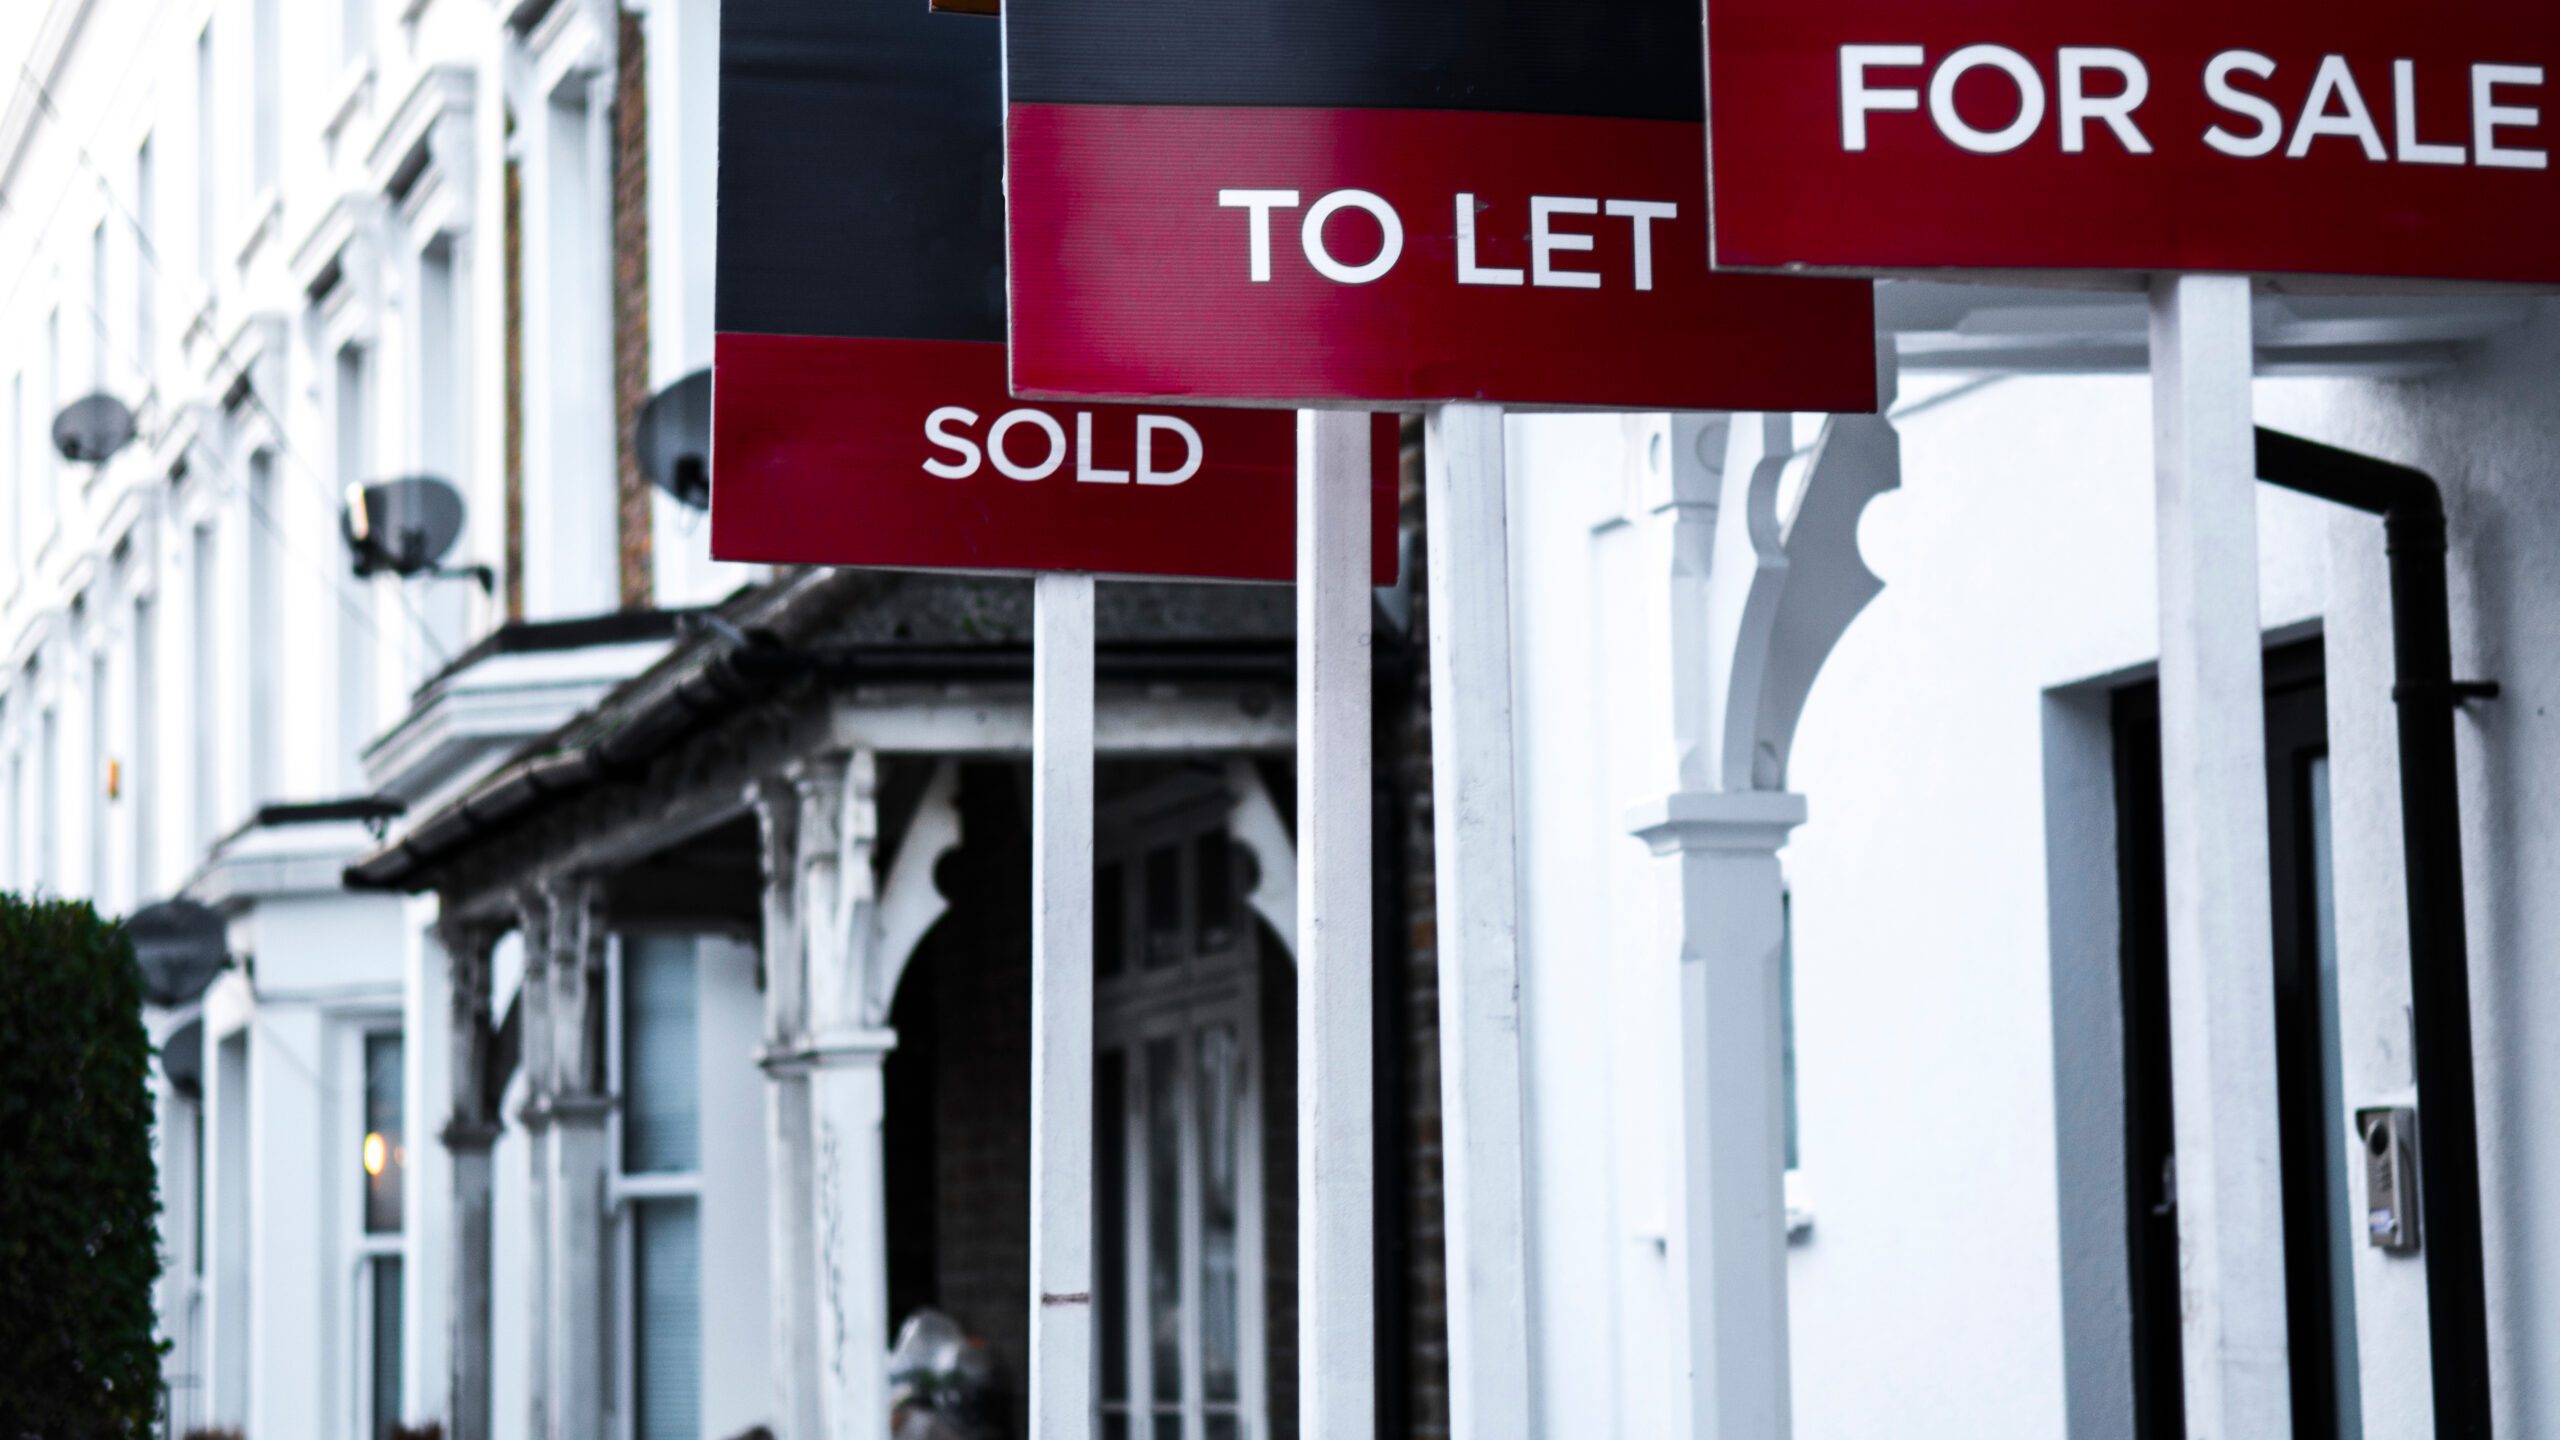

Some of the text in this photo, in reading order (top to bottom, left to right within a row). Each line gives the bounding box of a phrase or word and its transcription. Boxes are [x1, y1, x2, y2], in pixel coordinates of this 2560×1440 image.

[1839, 44, 2547, 170] FOR SALE
[1218, 188, 1677, 292] TO LET
[922, 406, 1203, 487] SOLD
